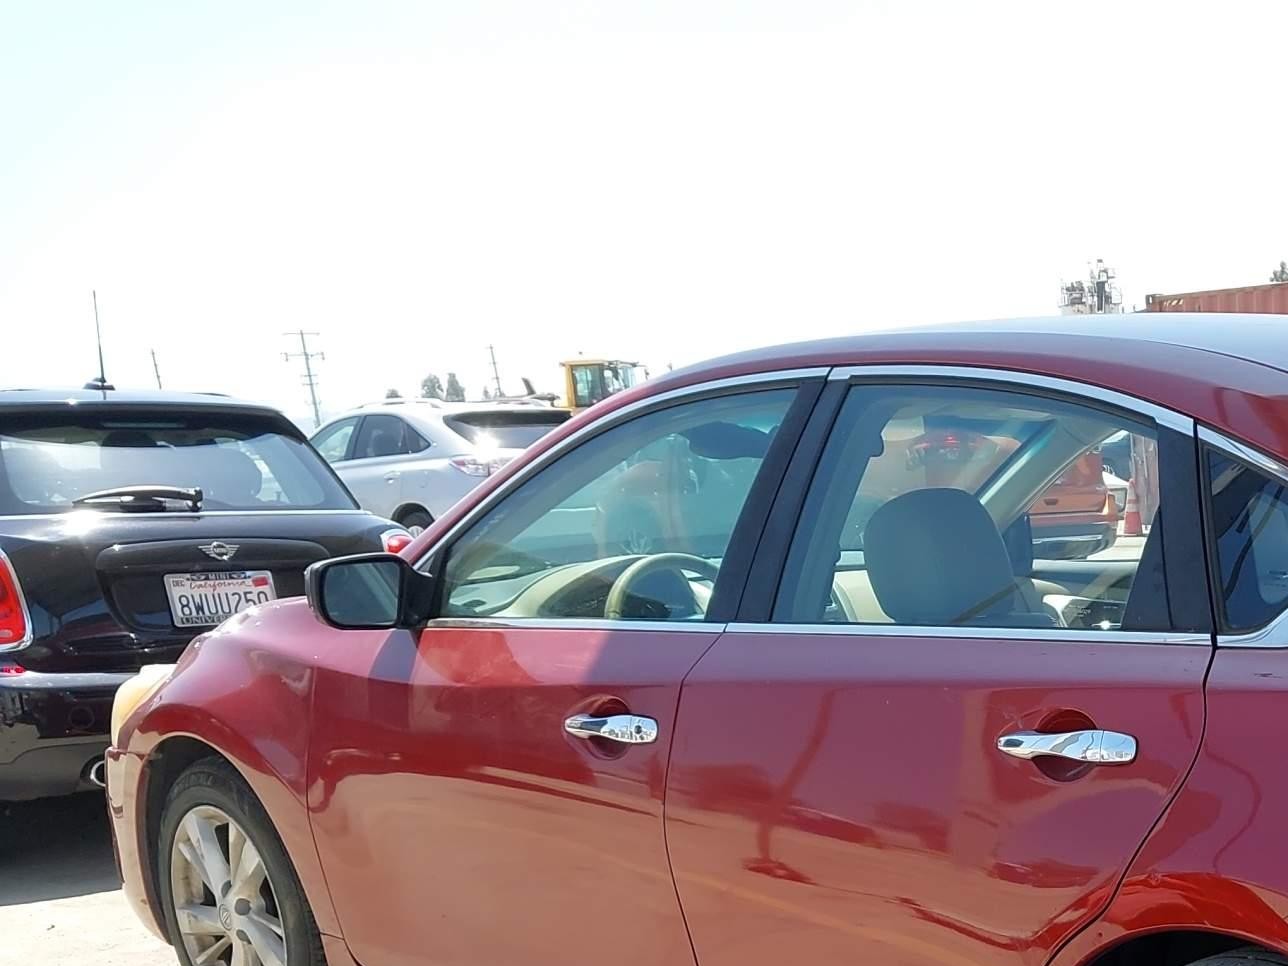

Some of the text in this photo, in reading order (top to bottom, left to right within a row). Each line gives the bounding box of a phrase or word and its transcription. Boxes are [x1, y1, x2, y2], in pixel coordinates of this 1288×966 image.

[208, 572, 230, 581] MINI
[172, 580, 186, 588] DEC
[189, 580, 252, 592] California
